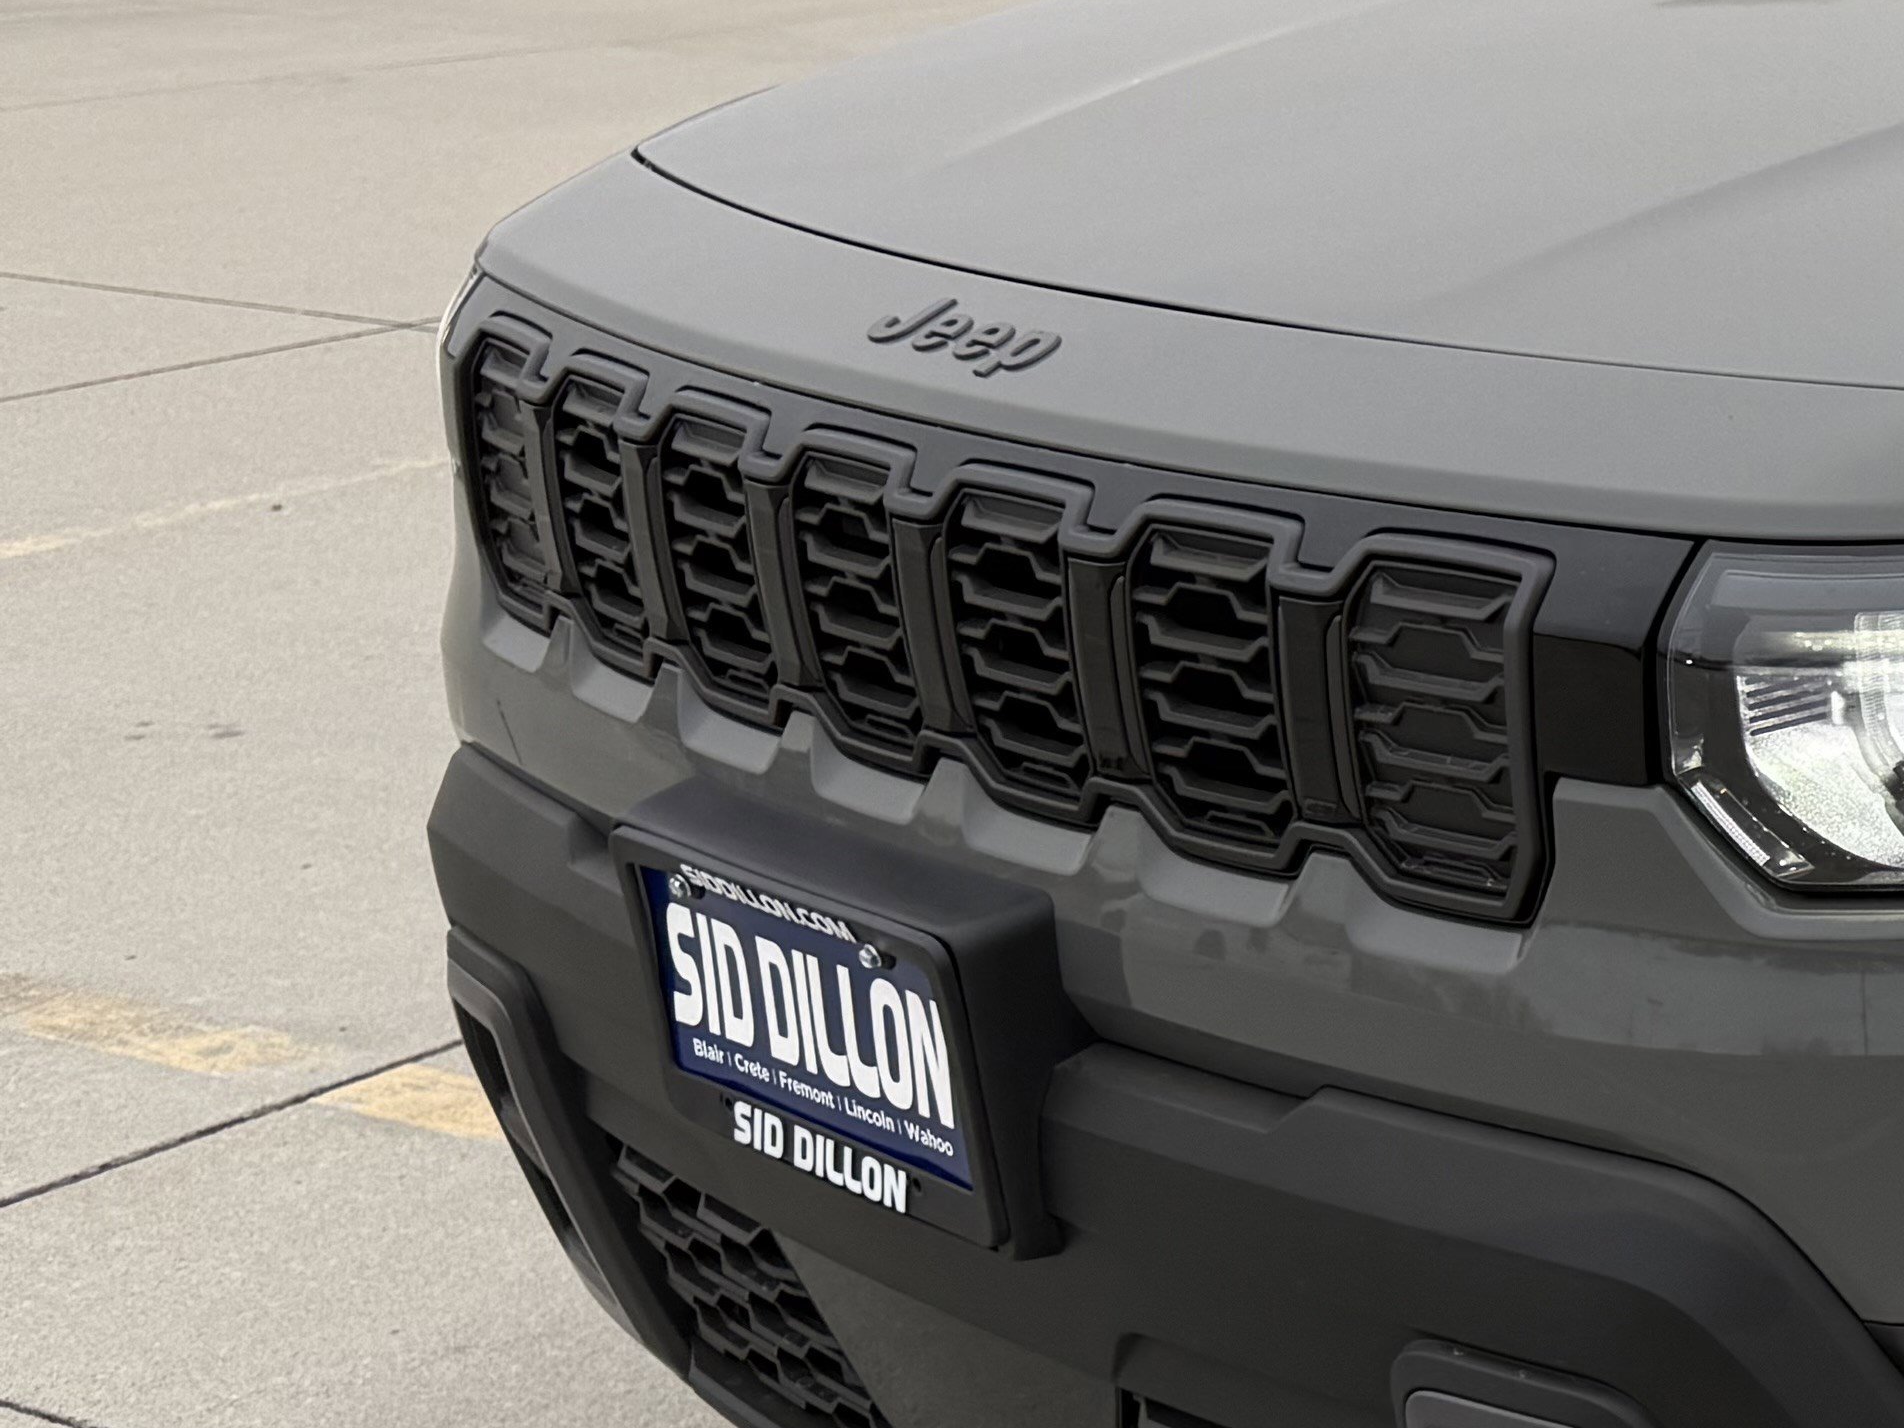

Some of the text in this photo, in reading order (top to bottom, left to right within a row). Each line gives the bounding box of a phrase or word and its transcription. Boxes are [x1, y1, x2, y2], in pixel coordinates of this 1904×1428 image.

[867, 298, 1062, 378] Jeep
[680, 864, 857, 943] SIDDILLON.COM
[666, 902, 955, 1129] SID DILLON
[693, 1037, 954, 1157] Blair Crete Fremont Lincoln Wahoo
[733, 1100, 907, 1214] SID DILLON
